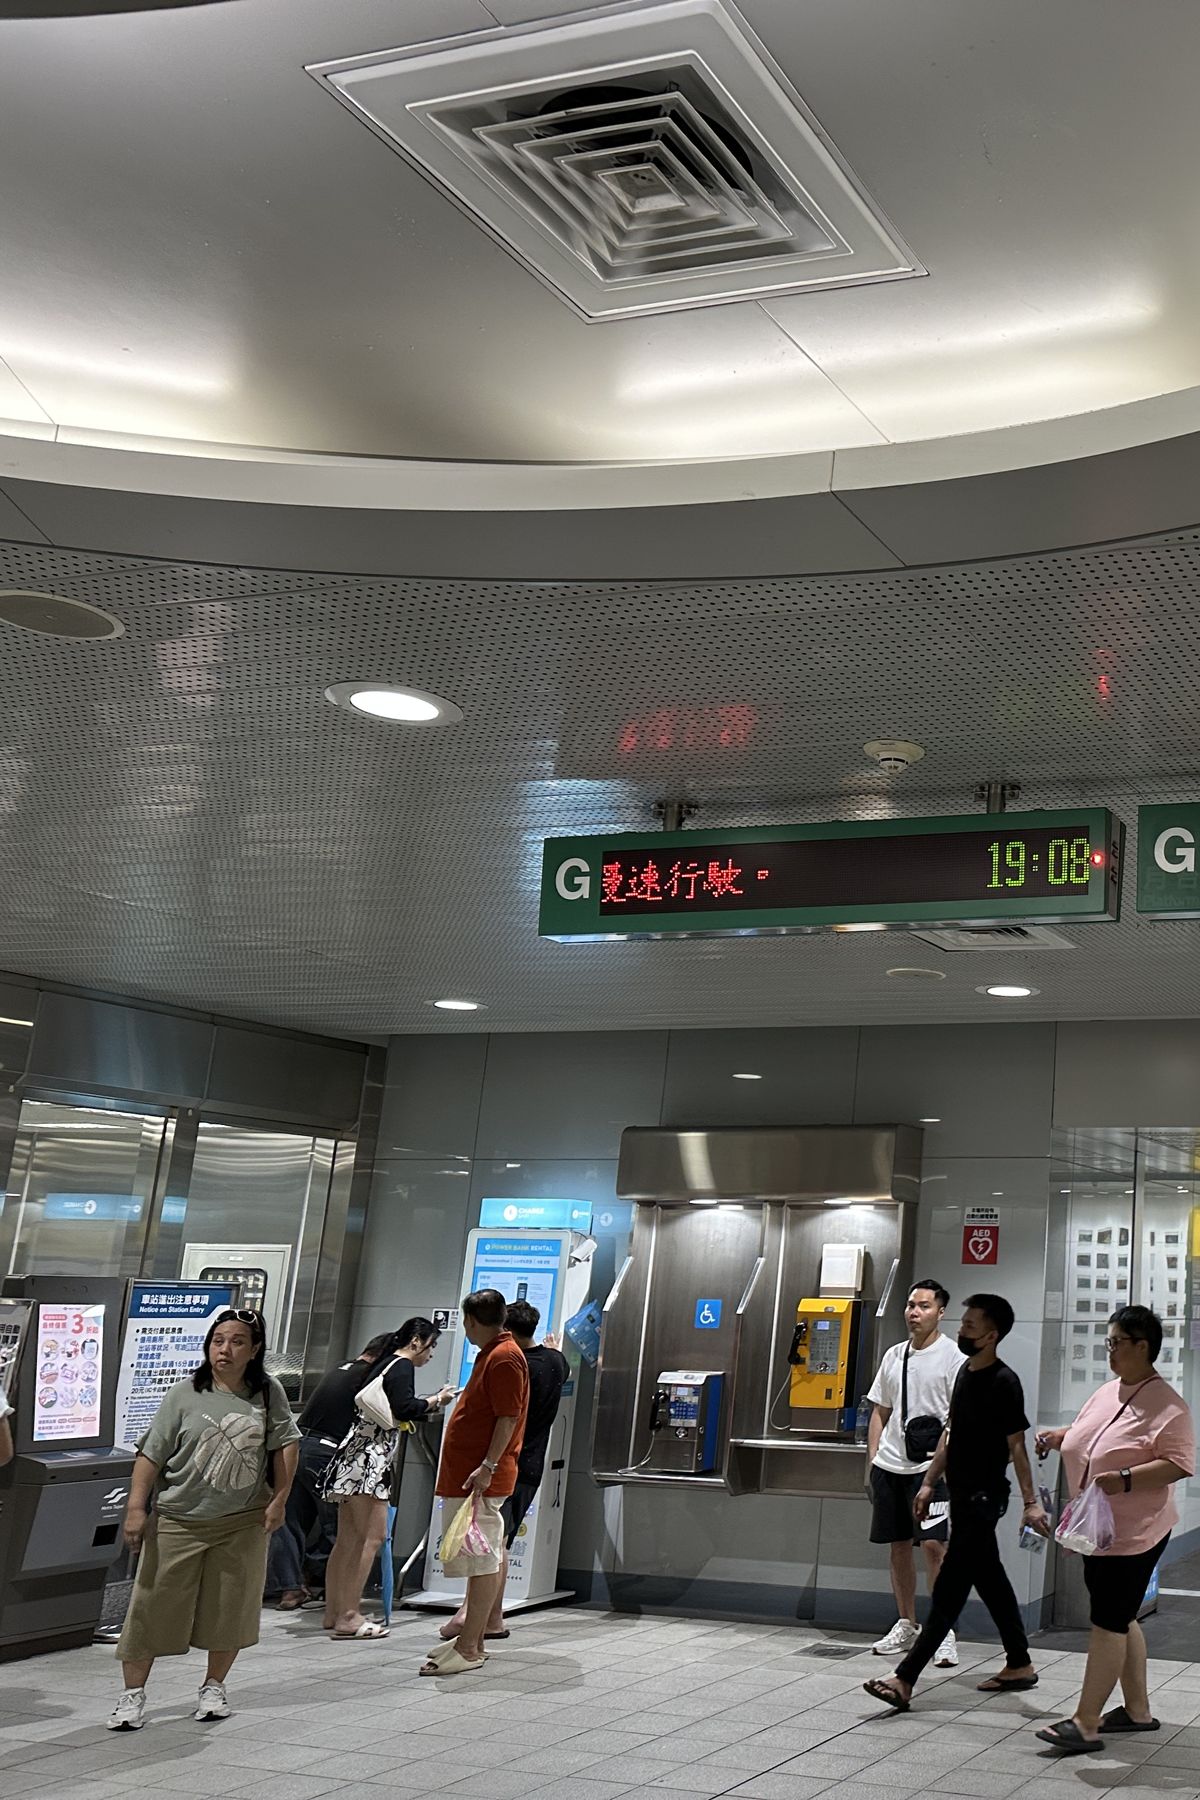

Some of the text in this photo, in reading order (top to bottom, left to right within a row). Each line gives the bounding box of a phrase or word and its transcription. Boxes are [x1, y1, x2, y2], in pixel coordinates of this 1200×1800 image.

[986, 838, 1090, 887] 19:08
[1154, 827, 1195, 873] G
[555, 858, 591, 900] G
[972, 1229, 990, 1237] AED
[71, 1314, 84, 1334] 3
[189, 1306, 205, 1314] Entry
